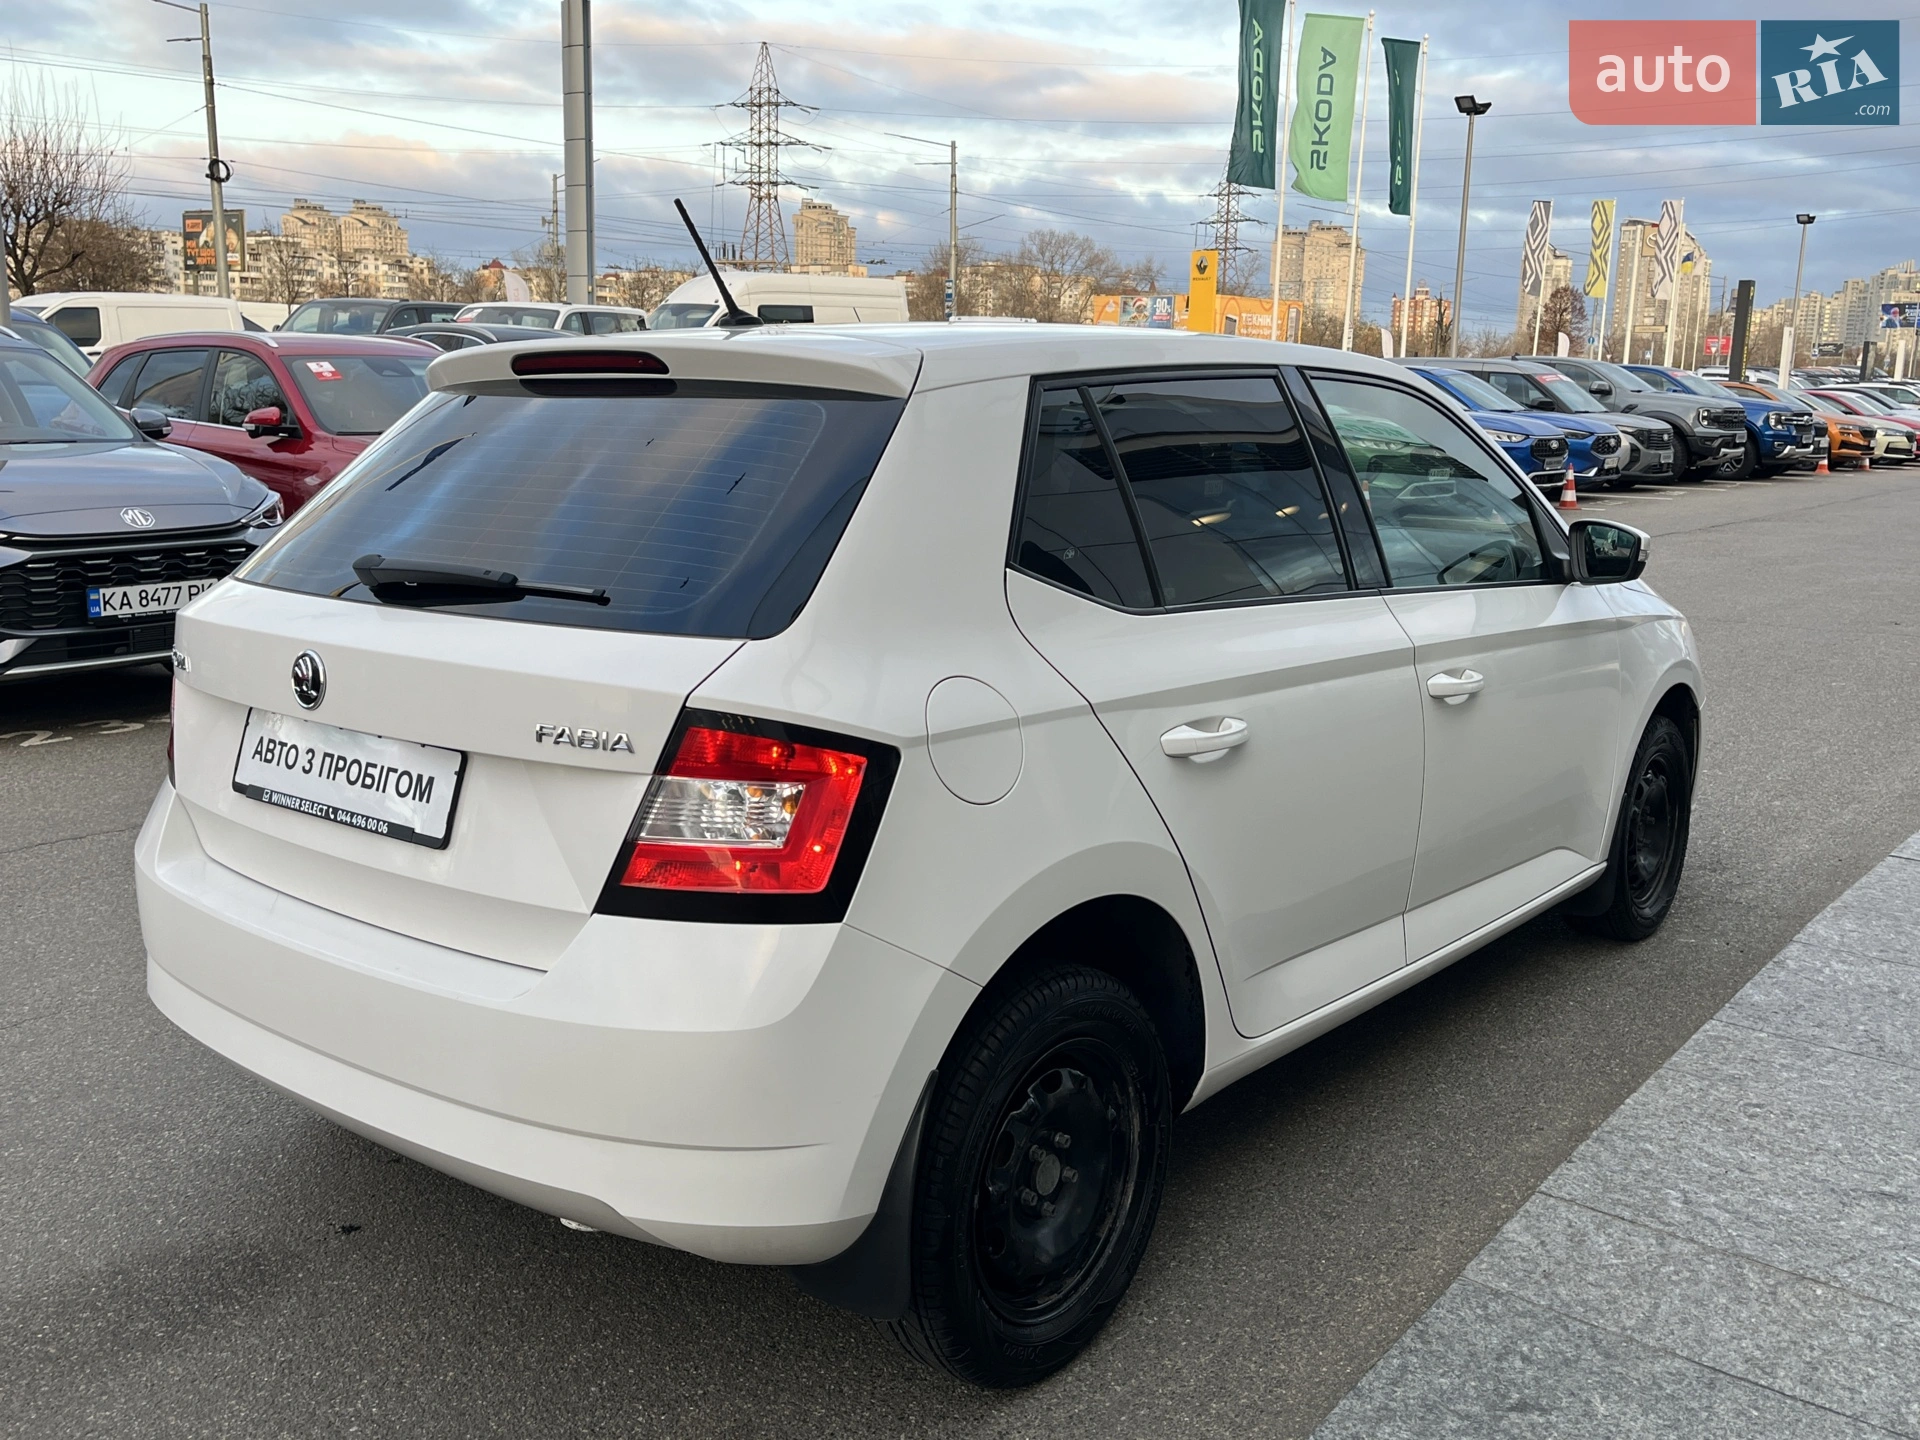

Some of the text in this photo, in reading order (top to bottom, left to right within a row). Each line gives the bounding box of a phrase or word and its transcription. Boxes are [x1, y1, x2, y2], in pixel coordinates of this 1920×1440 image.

[122, 508, 153, 527] MG
[102, 591, 133, 612] KA
[138, 586, 182, 608] 8477
[535, 723, 636, 754] FABIA
[252, 736, 299, 770] АВТО
[318, 751, 435, 804] ПРОБІГОМ
[271, 792, 389, 834] WINNER SELECT 044 496 00 06
